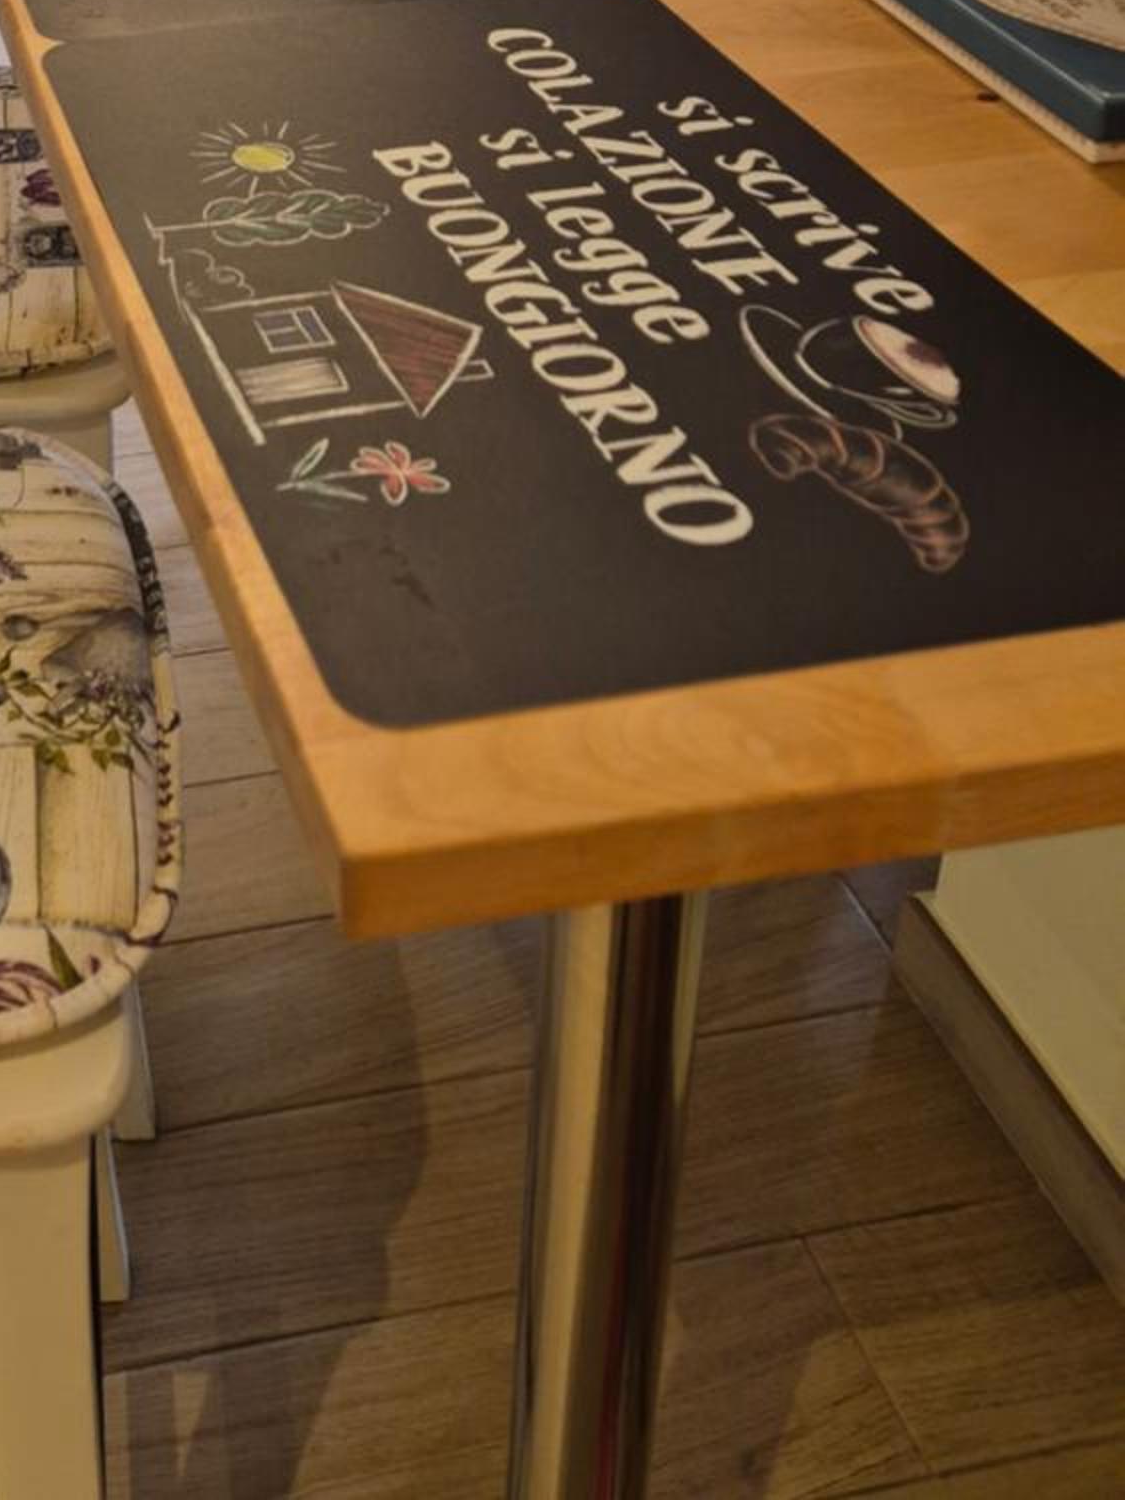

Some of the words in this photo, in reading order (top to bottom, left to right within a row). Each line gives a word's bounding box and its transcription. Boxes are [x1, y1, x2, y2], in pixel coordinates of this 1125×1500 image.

[479, 128, 573, 170] si
[526, 182, 710, 343] legge
[487, 28, 798, 295] COLAZIONE
[658, 96, 754, 135] si
[715, 149, 933, 314] scrive
[373, 141, 753, 545] BUONGIORNO
